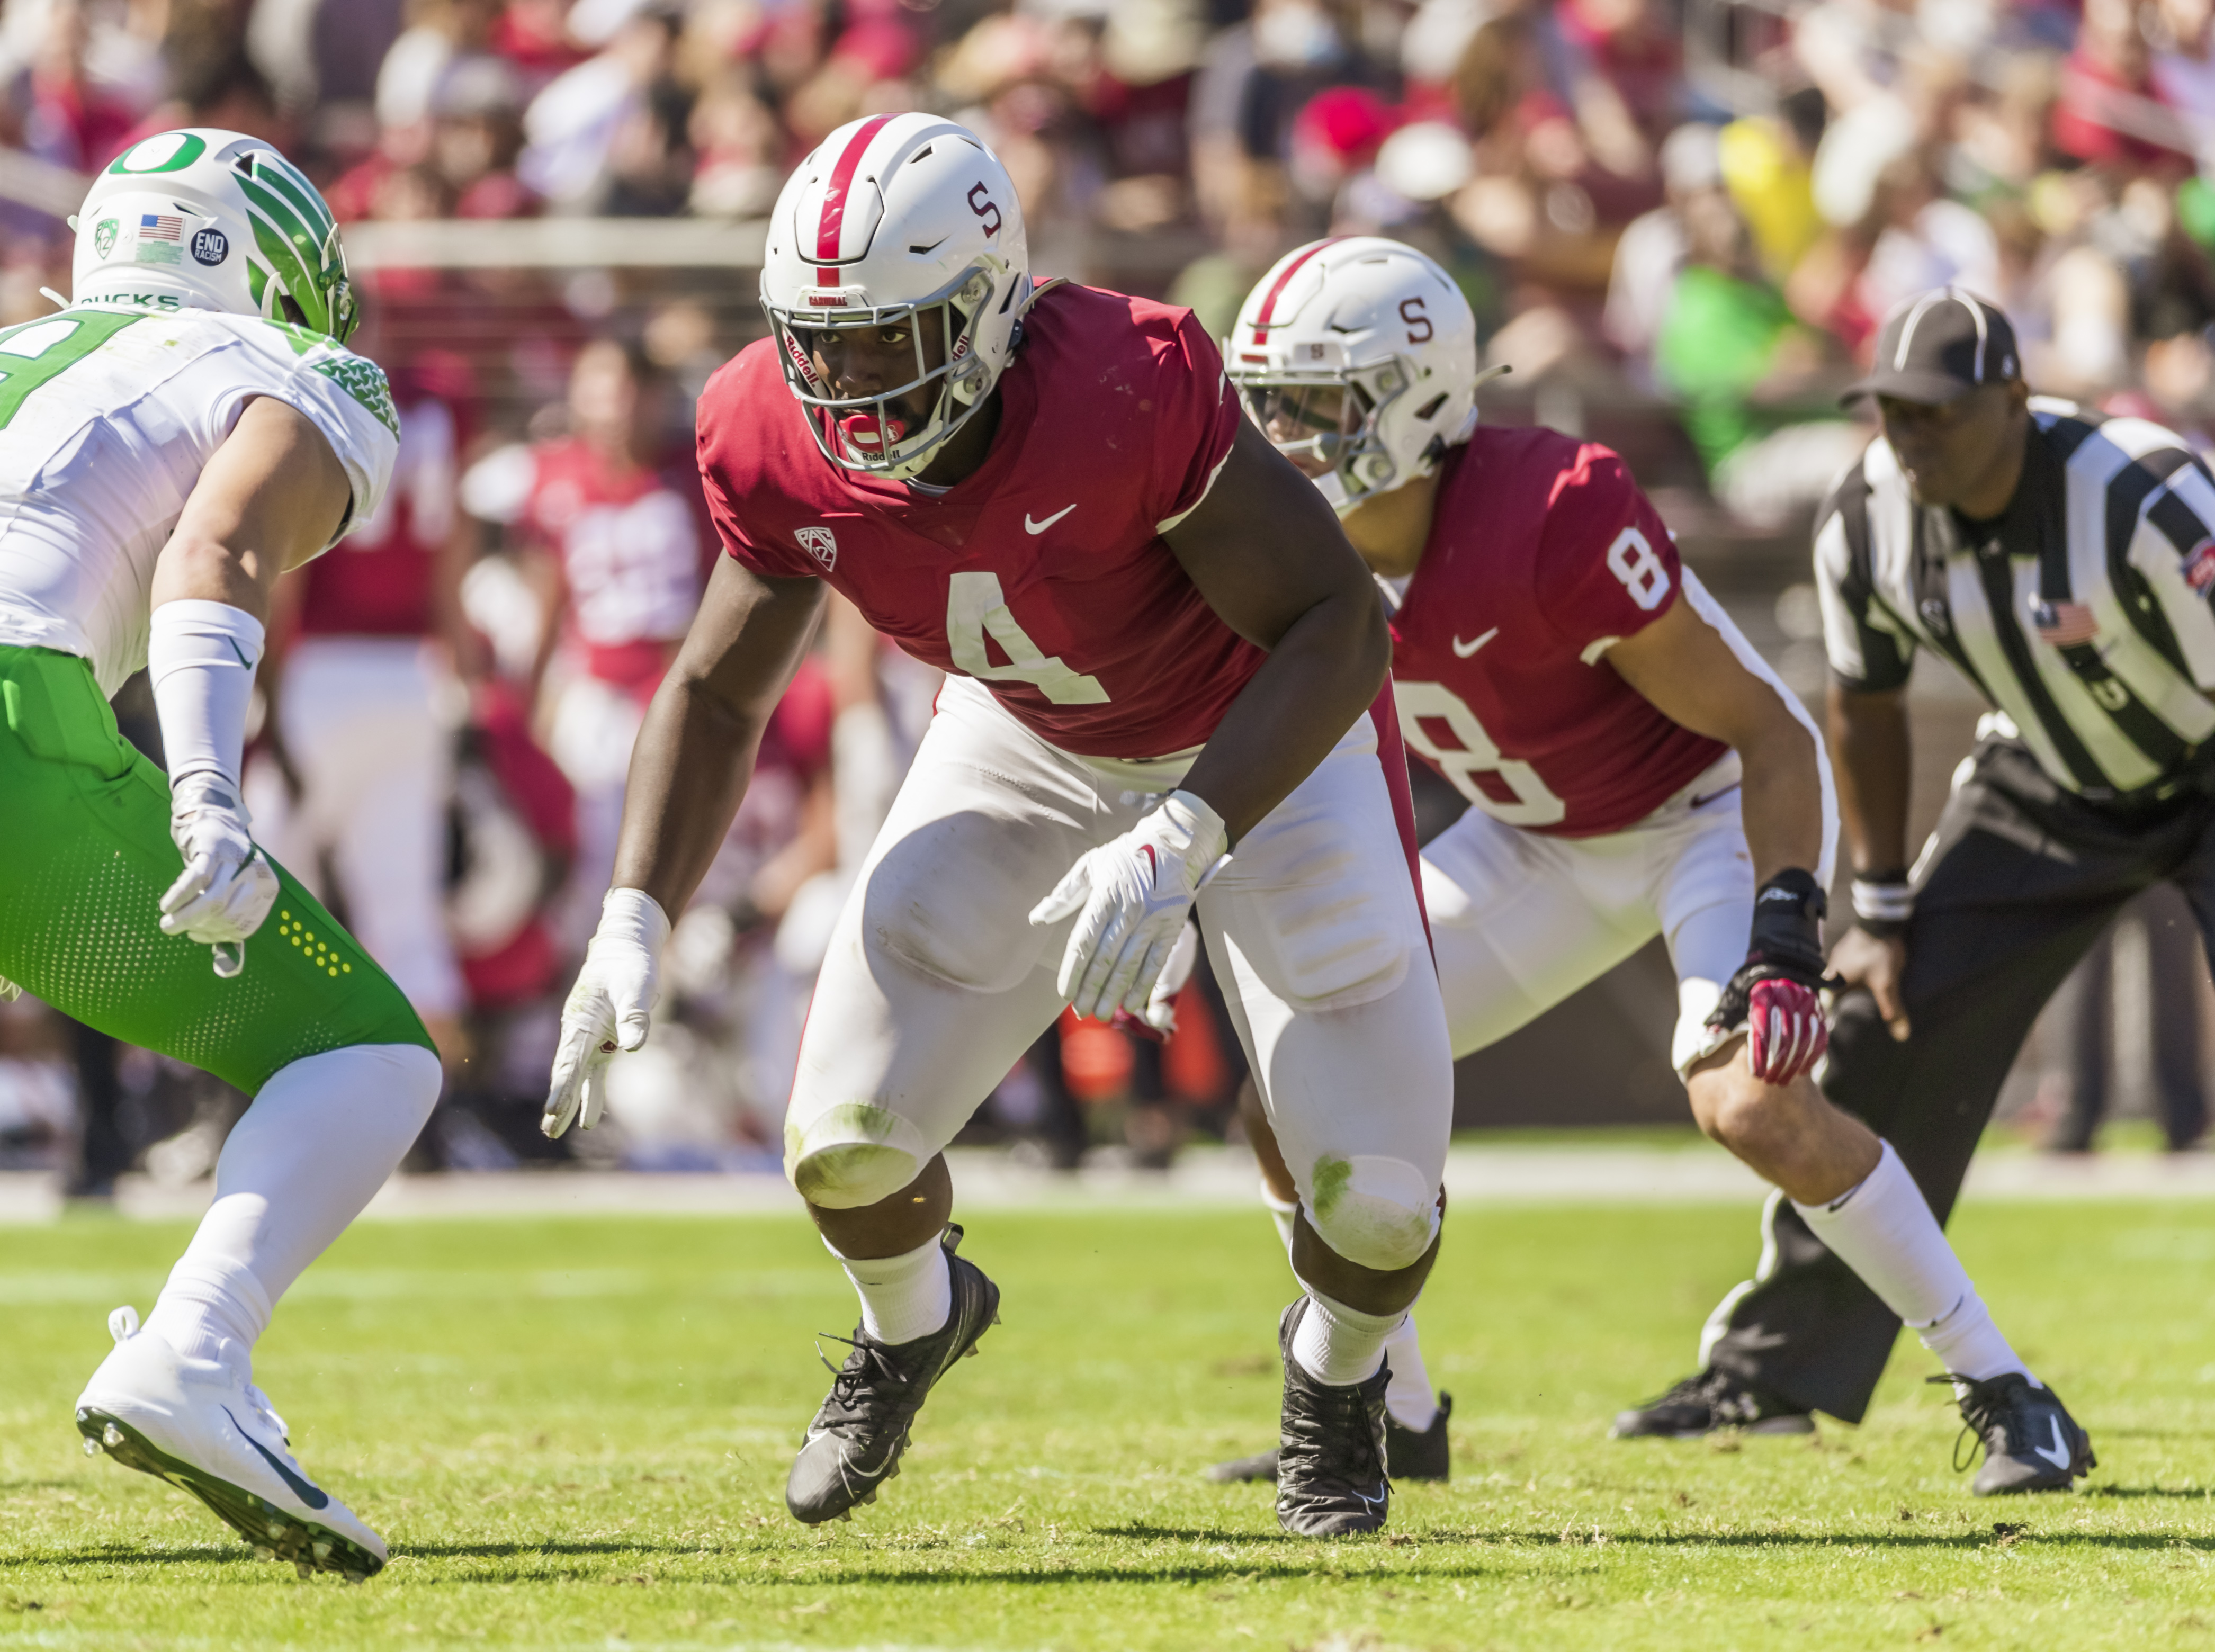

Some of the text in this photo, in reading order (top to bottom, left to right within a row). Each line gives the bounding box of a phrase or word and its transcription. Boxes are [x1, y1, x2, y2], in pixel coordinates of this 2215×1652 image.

[967, 181, 1001, 238] S
[96, 219, 119, 241] PAC
[99, 236, 111, 251] 12
[195, 232, 224, 253] END
[194, 249, 222, 262] RACISM
[1398, 297, 1433, 345] S
[862, 450, 900, 461] Riddll
[797, 528, 834, 554] PAC
[813, 546, 832, 561] 12
[1607, 527, 1670, 610] 8
[946, 572, 1111, 704] 4
[1393, 681, 1565, 826] 8
